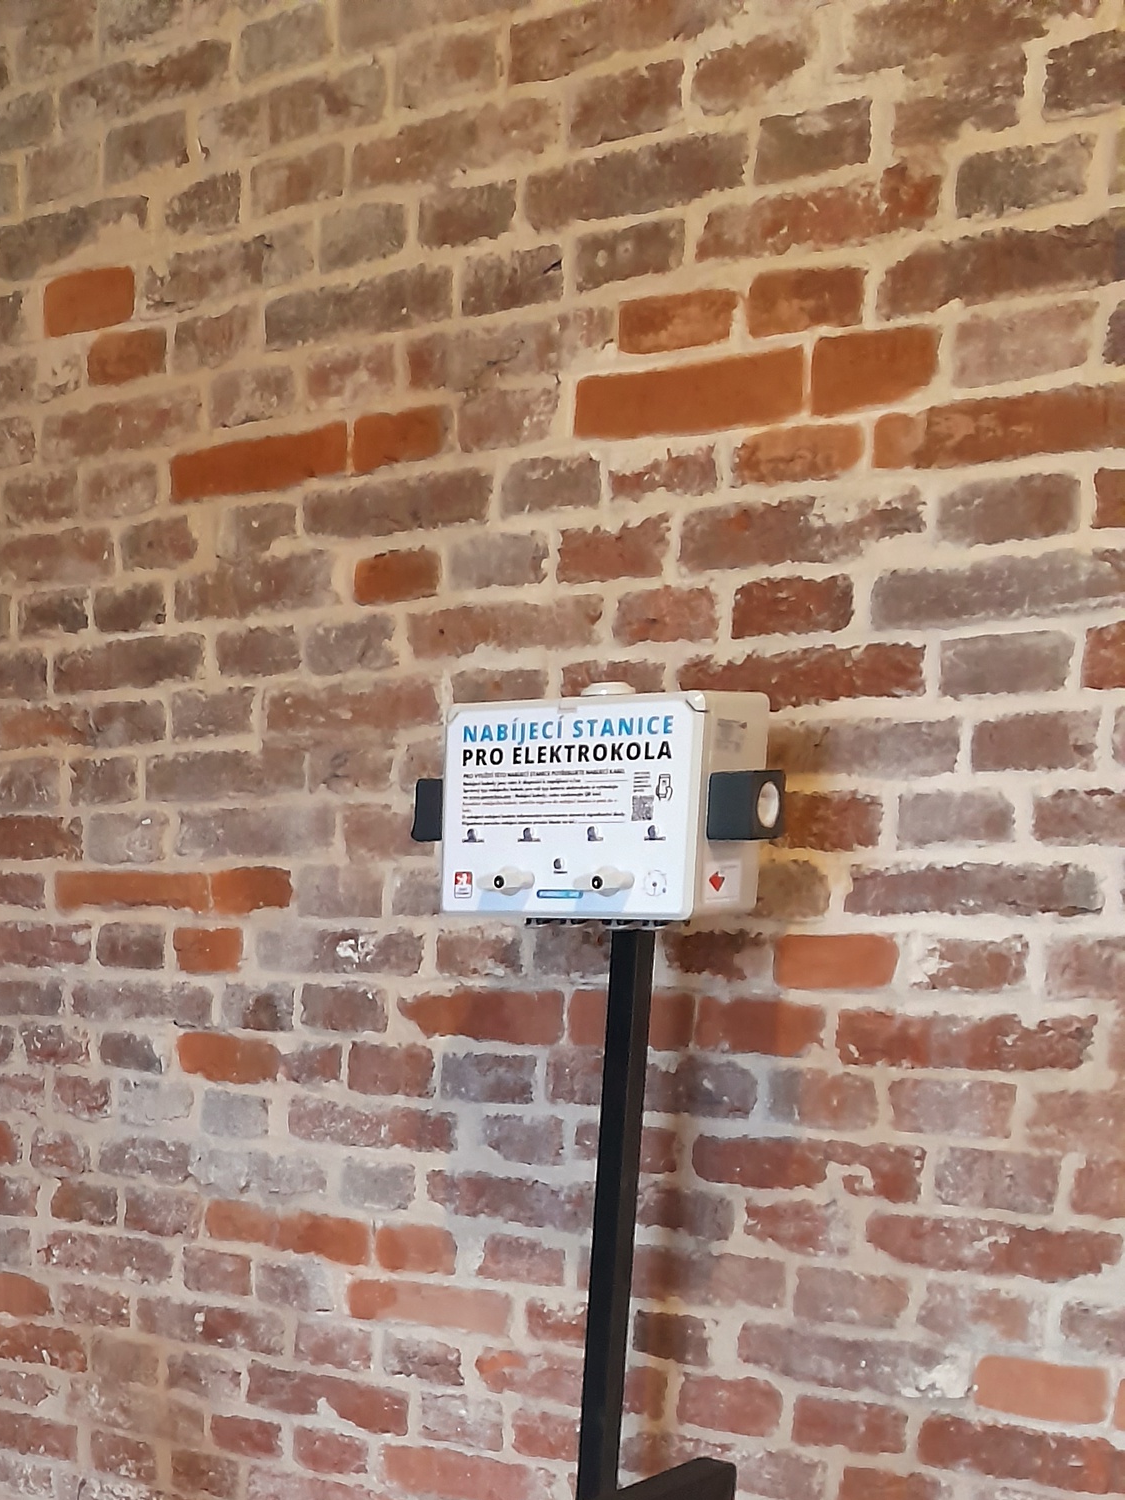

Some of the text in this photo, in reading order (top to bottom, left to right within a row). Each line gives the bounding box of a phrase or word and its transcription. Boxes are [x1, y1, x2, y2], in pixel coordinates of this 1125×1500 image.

[463, 714, 674, 745] NABÍJECÍ STANICE
[462, 741, 673, 767] PRO ELEKTROKOLA
